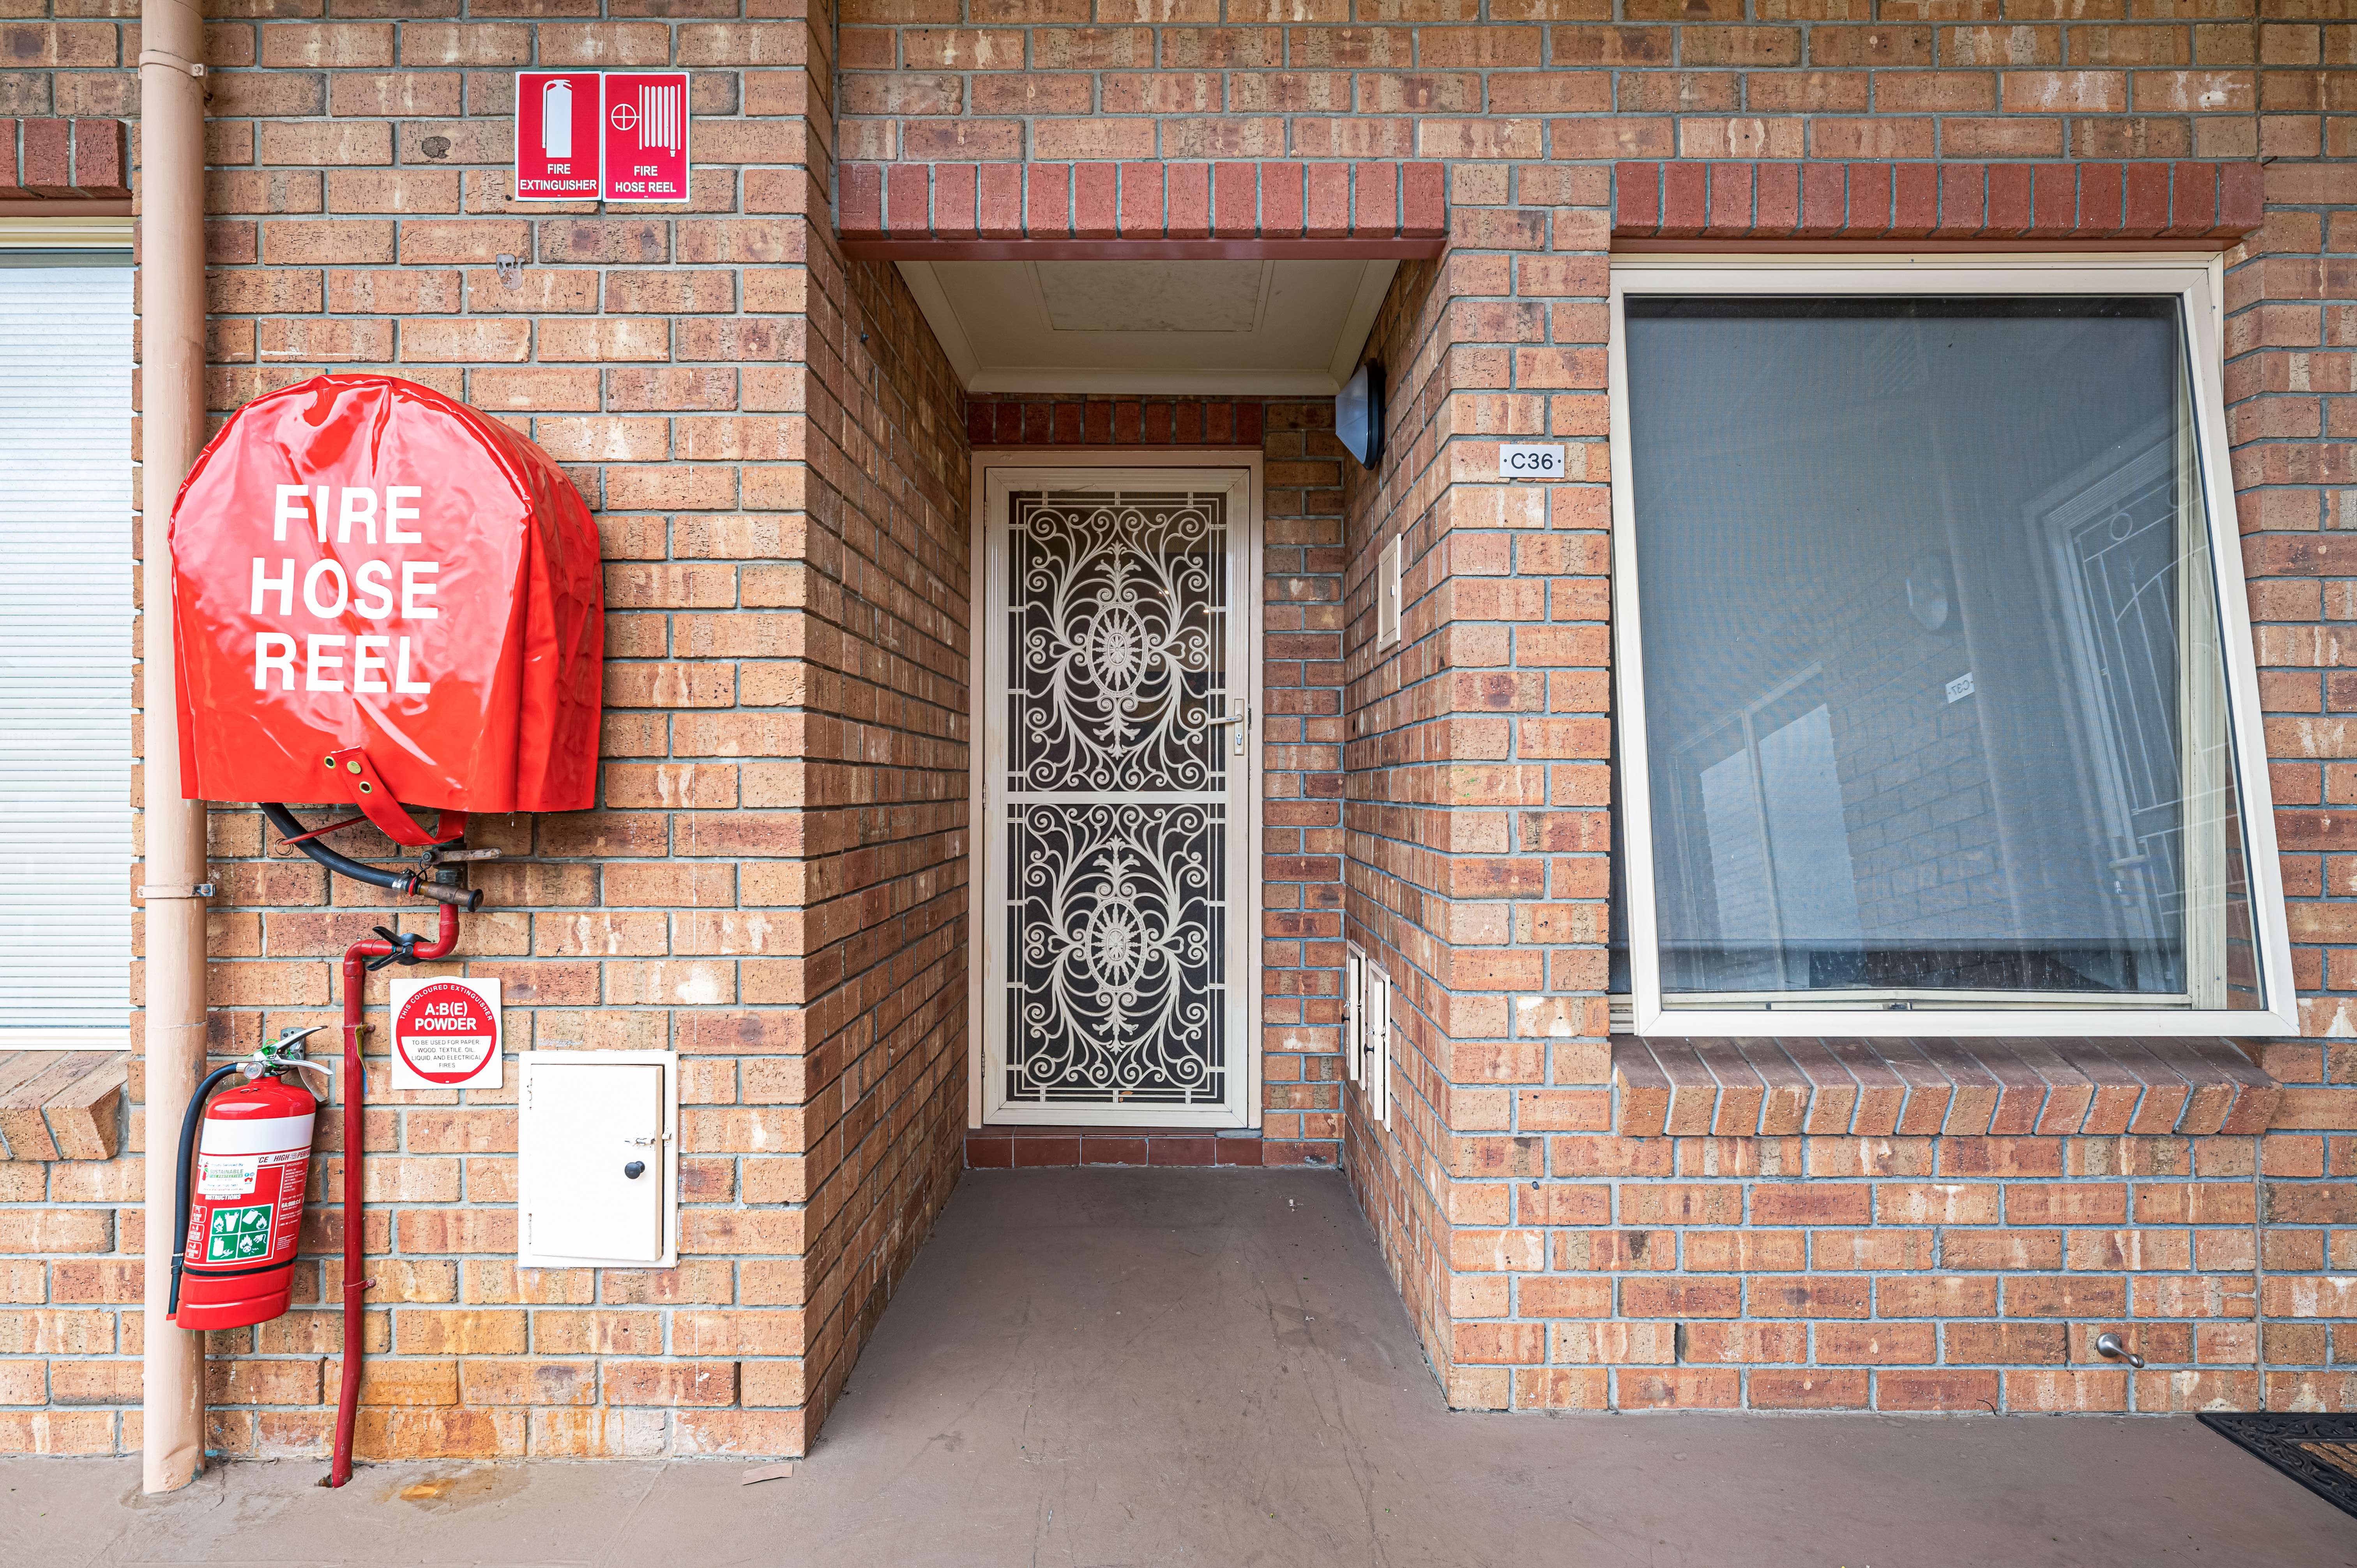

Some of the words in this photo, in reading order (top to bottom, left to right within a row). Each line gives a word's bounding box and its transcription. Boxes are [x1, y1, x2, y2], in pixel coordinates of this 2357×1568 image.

[547, 164, 571, 174] FIRE
[634, 166, 658, 176] FIRE
[520, 180, 597, 190] EXTINGUISHER
[615, 182, 645, 192] HOSE
[648, 182, 677, 192] REEL
[1511, 453, 1553, 470] C36
[274, 484, 422, 544] FIRE
[251, 557, 439, 620] HOSE
[254, 632, 431, 694] REEL
[400, 1004, 411, 1019] THIS
[410, 985, 448, 1004] COLOURED
[451, 985, 493, 1021] EXTINGUISHER
[425, 1001, 468, 1017] A:B(E)
[415, 1017, 477, 1031] POWDER
